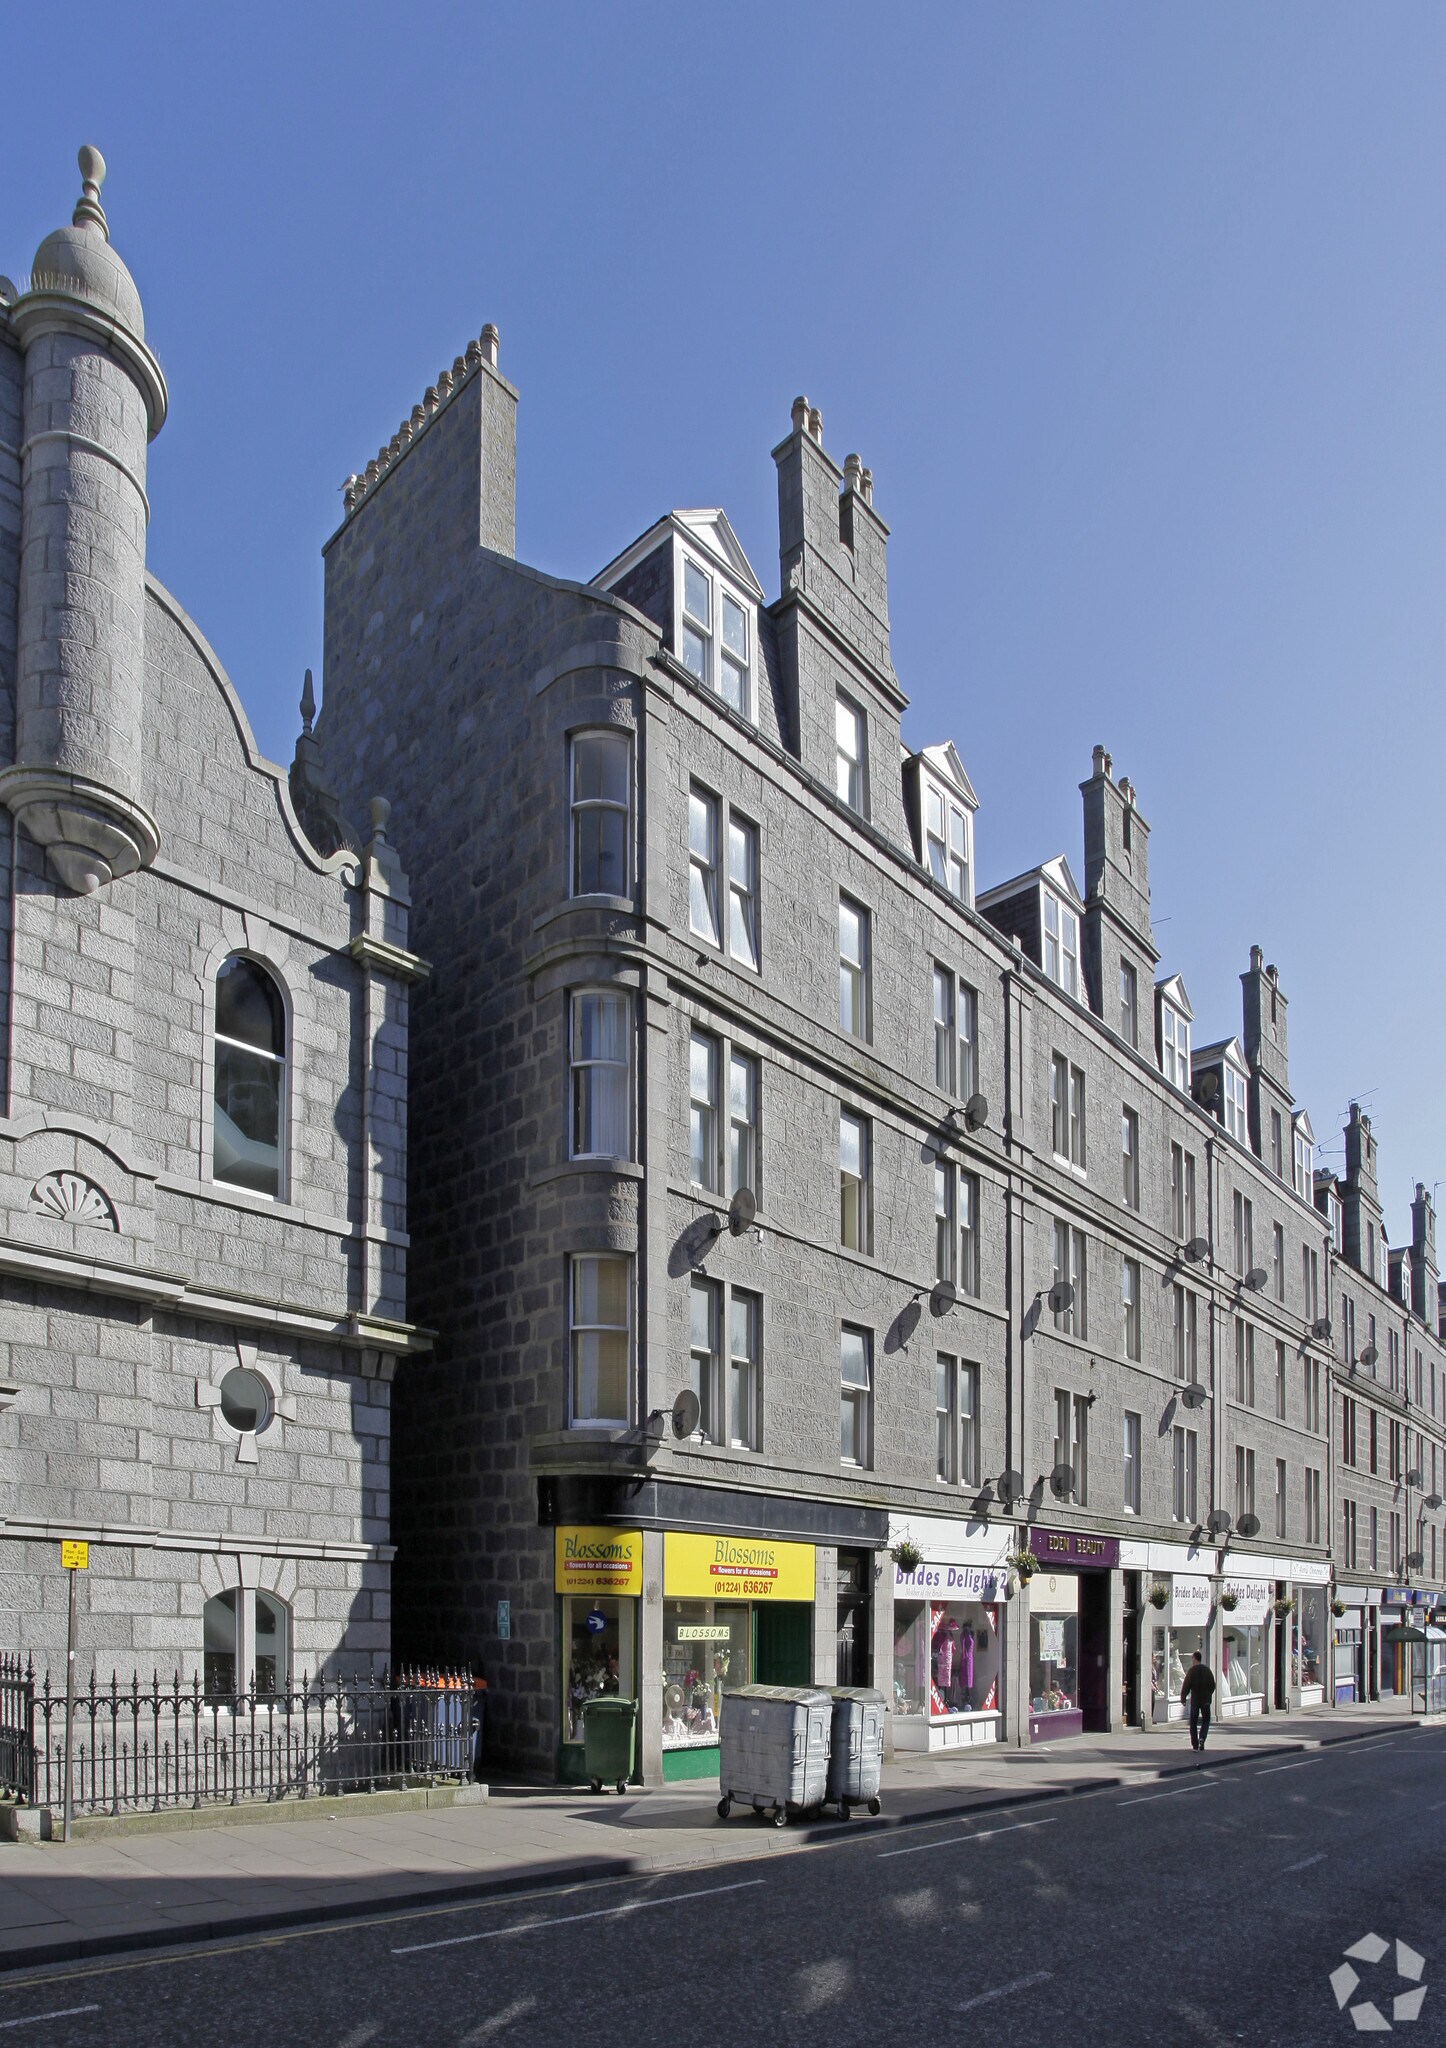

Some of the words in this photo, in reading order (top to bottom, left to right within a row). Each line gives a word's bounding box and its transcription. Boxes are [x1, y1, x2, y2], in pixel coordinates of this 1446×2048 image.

[564, 1534, 633, 1559] Blossoms
[714, 1540, 775, 1566] Blossoms
[1048, 1535, 1070, 1551] EDEN
[1077, 1538, 1106, 1555] BEAUTY
[569, 1561, 587, 1569] flowers
[587, 1561, 595, 1569] for
[595, 1561, 603, 1569] all
[603, 1562, 628, 1570] occasions
[718, 1566, 735, 1574] flowers
[735, 1567, 743, 1575] for
[566, 1578, 594, 1586] (01224)
[596, 1577, 630, 1586] 636267
[714, 1581, 741, 1595] (01224)
[743, 1580, 773, 1594] 636267
[947, 1567, 993, 1593] Delight
[1000, 1572, 1007, 1589] 2
[1175, 1586, 1191, 1599] Brides
[1192, 1586, 1209, 1602] Delight
[1246, 1584, 1266, 1603] Delight
[679, 1628, 729, 1638] BLOSSOMS
